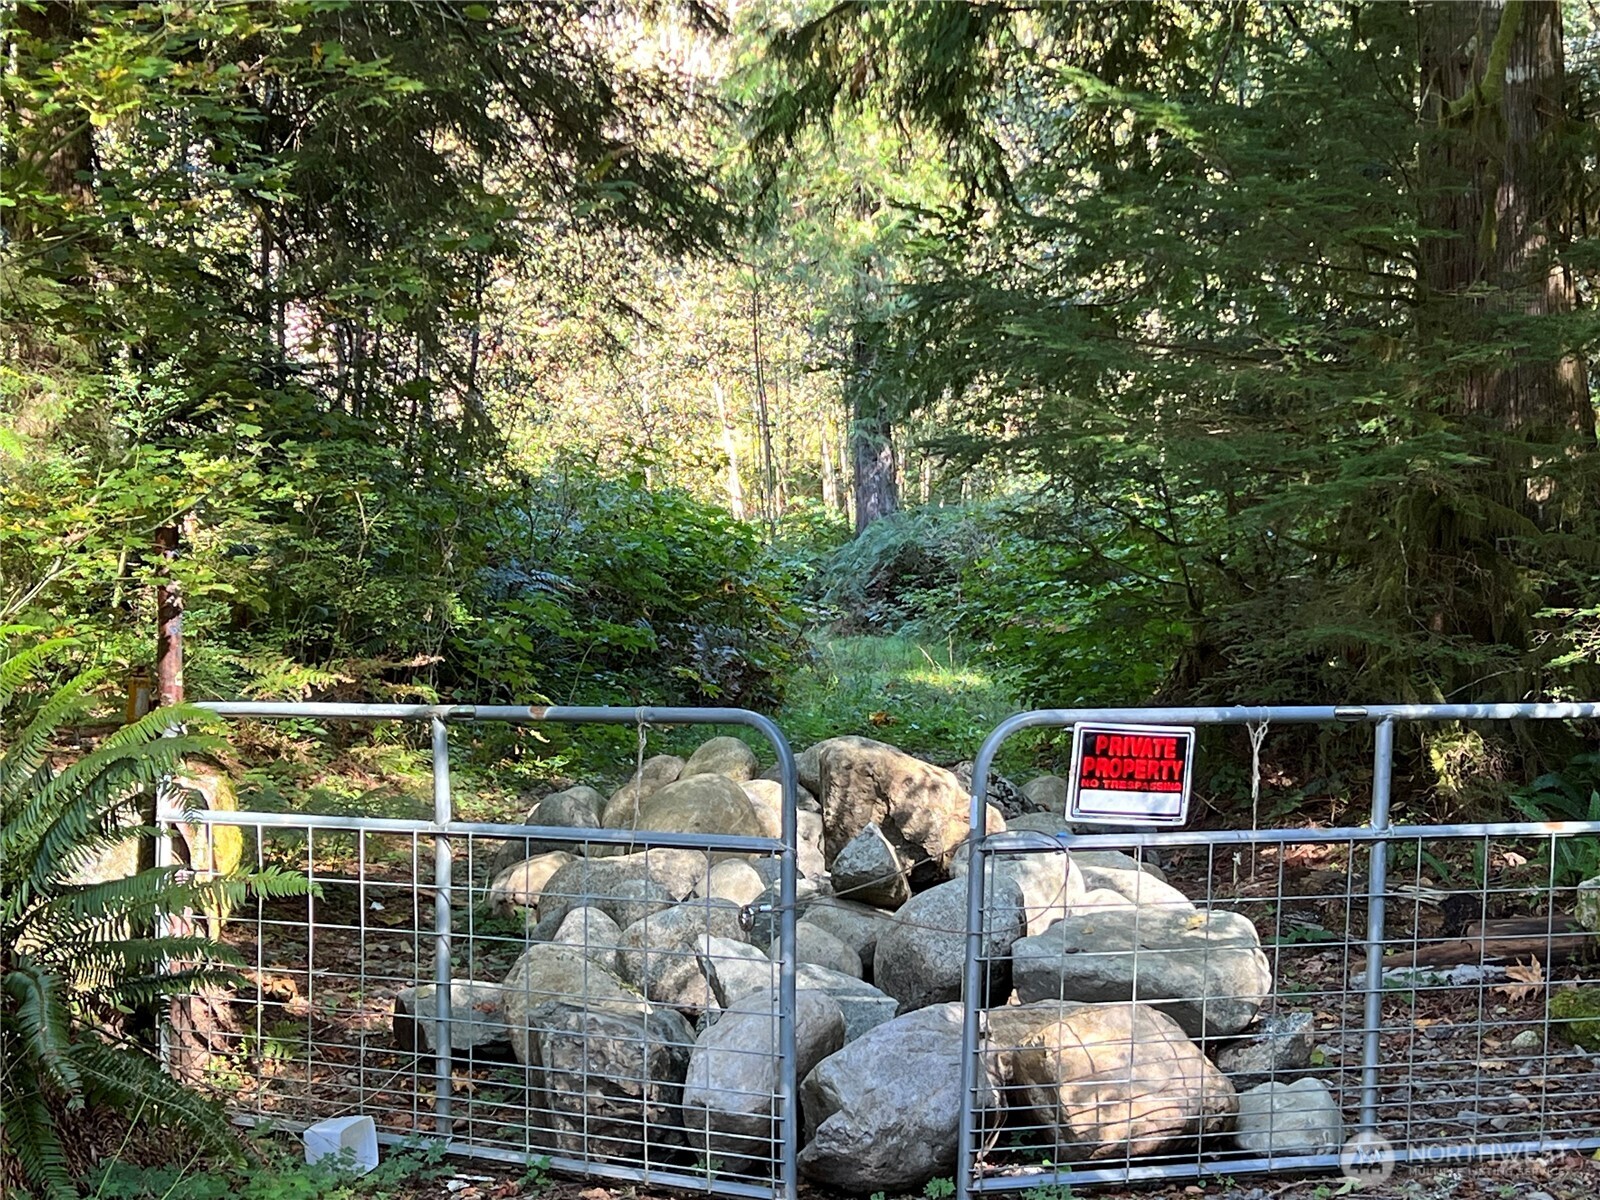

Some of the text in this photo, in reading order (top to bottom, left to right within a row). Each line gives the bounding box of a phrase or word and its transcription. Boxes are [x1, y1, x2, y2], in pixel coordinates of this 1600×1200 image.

[1095, 735, 1177, 758] PRIVATE
[1082, 756, 1183, 780] PROPERTY
[1081, 778, 1182, 791] NO TRESPASSING
